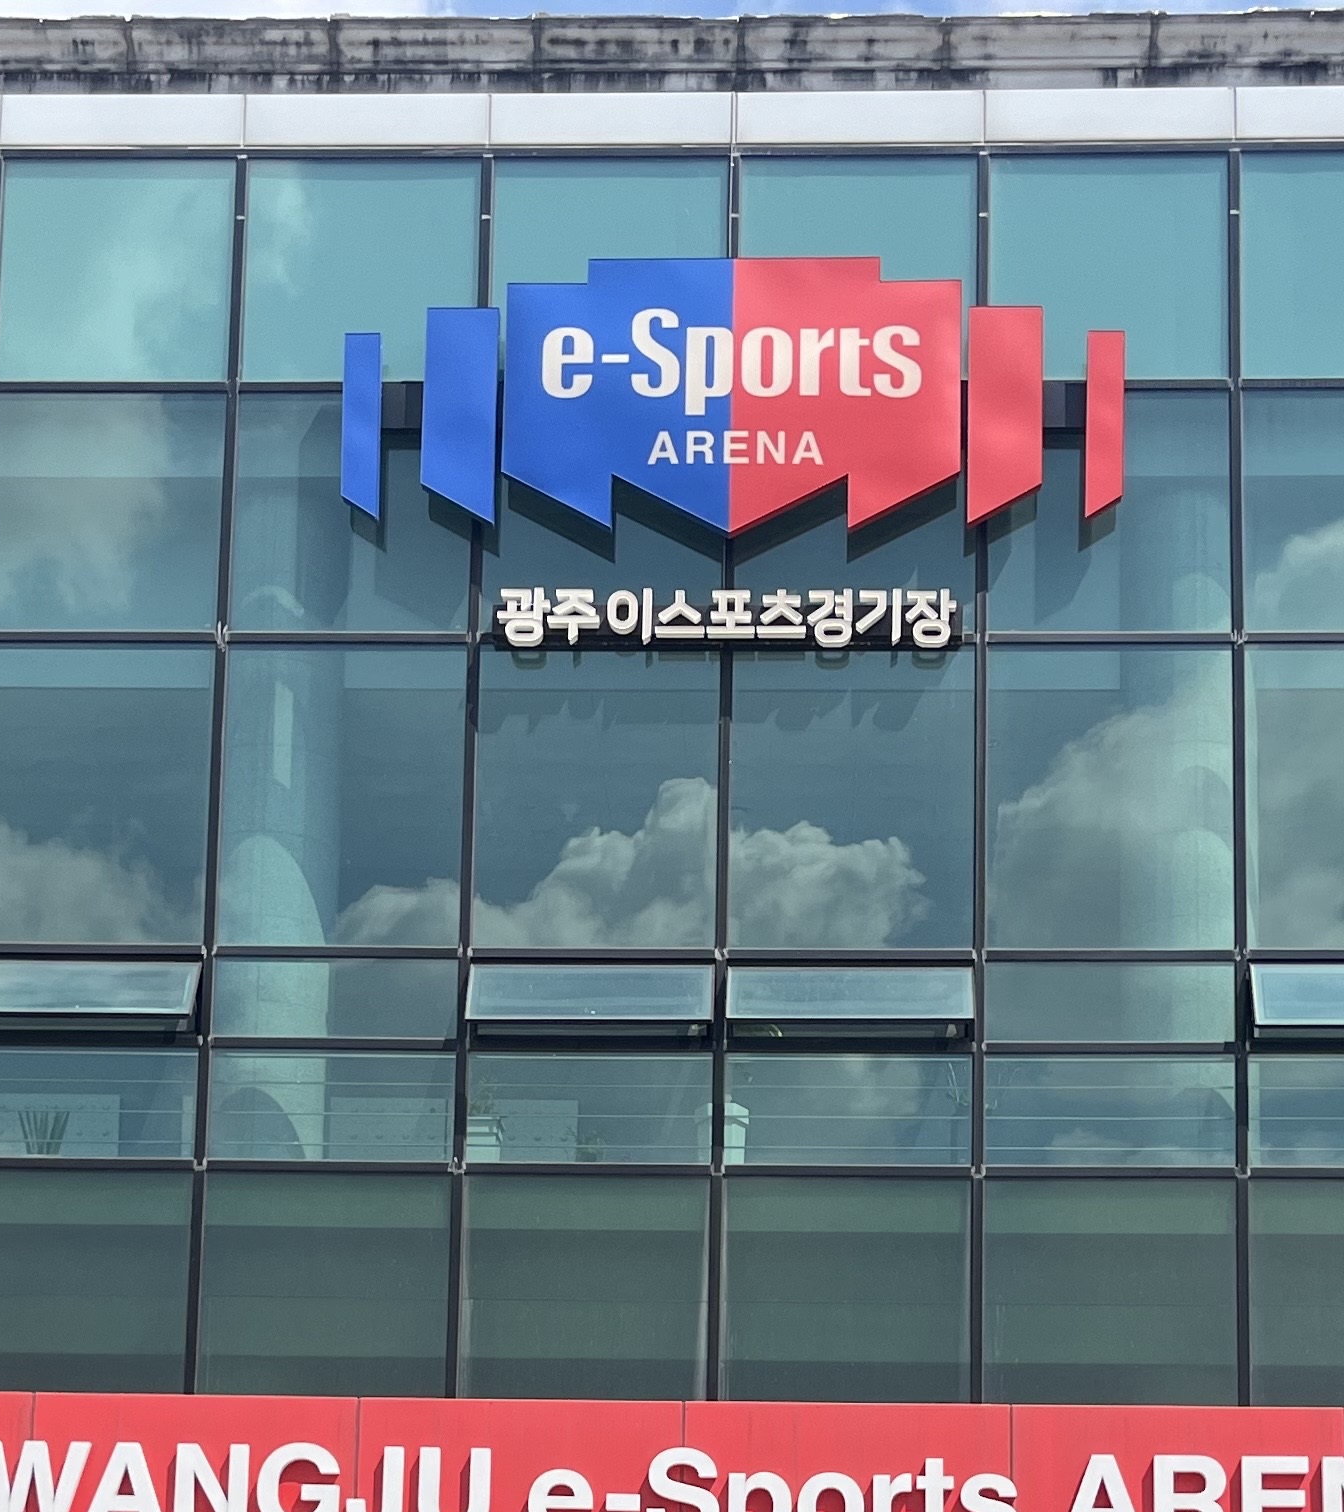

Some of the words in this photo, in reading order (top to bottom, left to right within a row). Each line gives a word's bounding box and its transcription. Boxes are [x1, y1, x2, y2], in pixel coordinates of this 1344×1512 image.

[542, 308, 923, 416] e-Sports
[647, 430, 823, 466] ARENA
[496, 587, 601, 647] 광주
[607, 587, 957, 648] 이스포츠경기장
